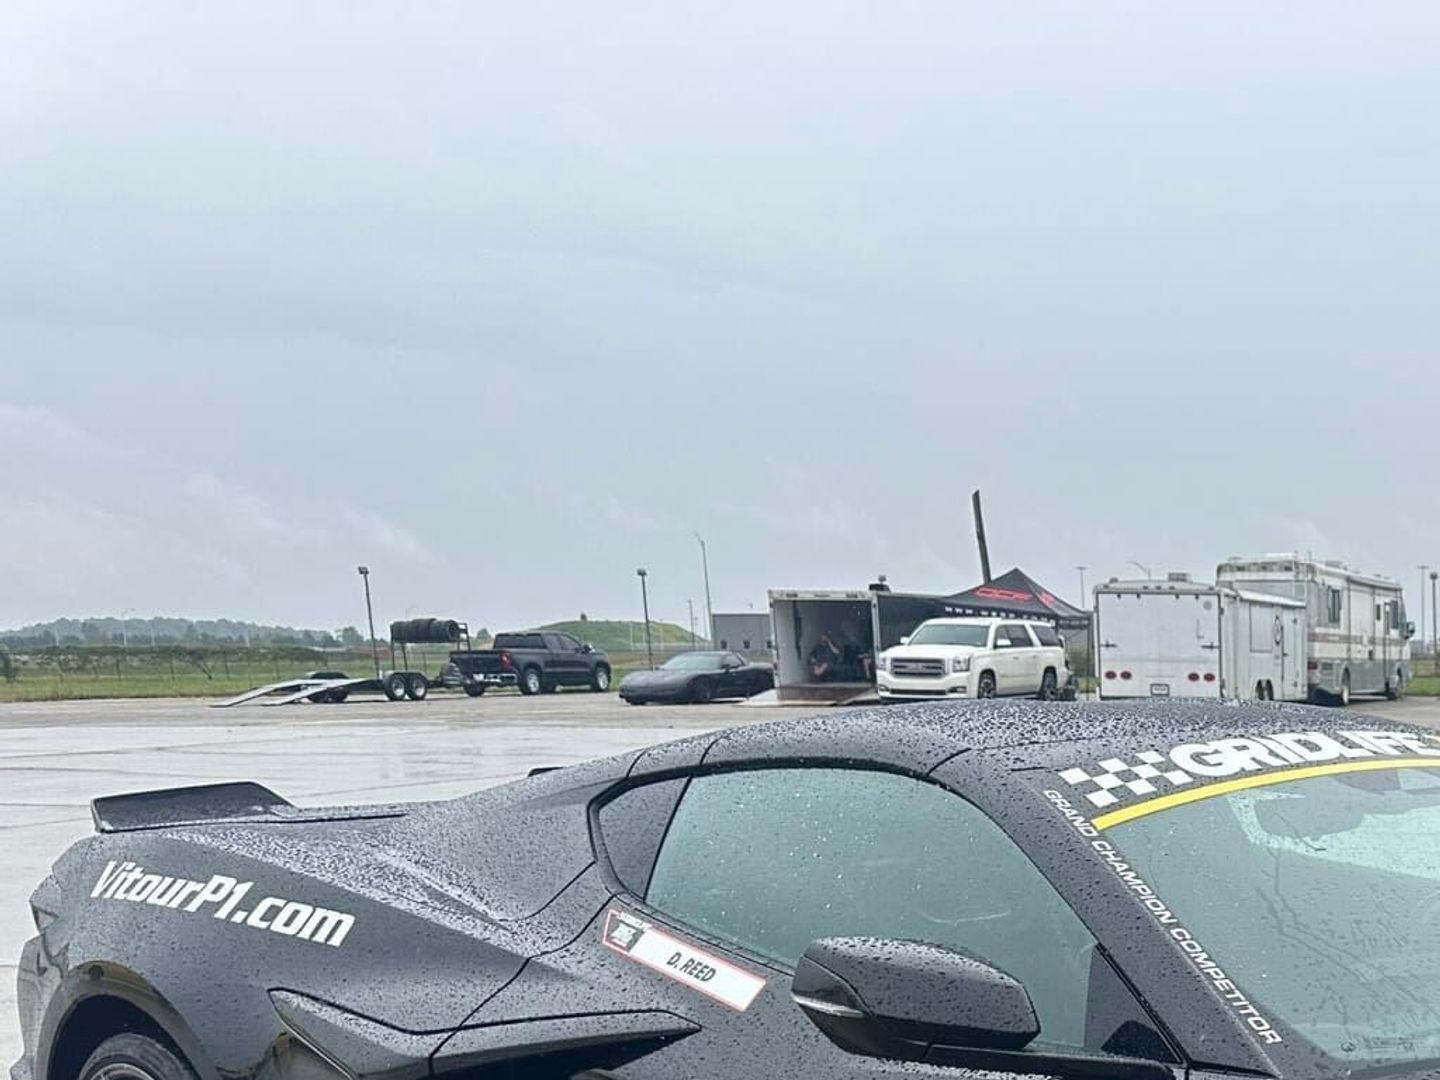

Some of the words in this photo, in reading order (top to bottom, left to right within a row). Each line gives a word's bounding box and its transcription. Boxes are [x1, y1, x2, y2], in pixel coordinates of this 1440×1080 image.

[90, 860, 356, 947] VitourP1.com
[1043, 789, 1099, 838] GRAND
[1091, 840, 1178, 924] CHAMPION
[1170, 927, 1283, 1045] COMPETITOR
[680, 958, 717, 983] REED
